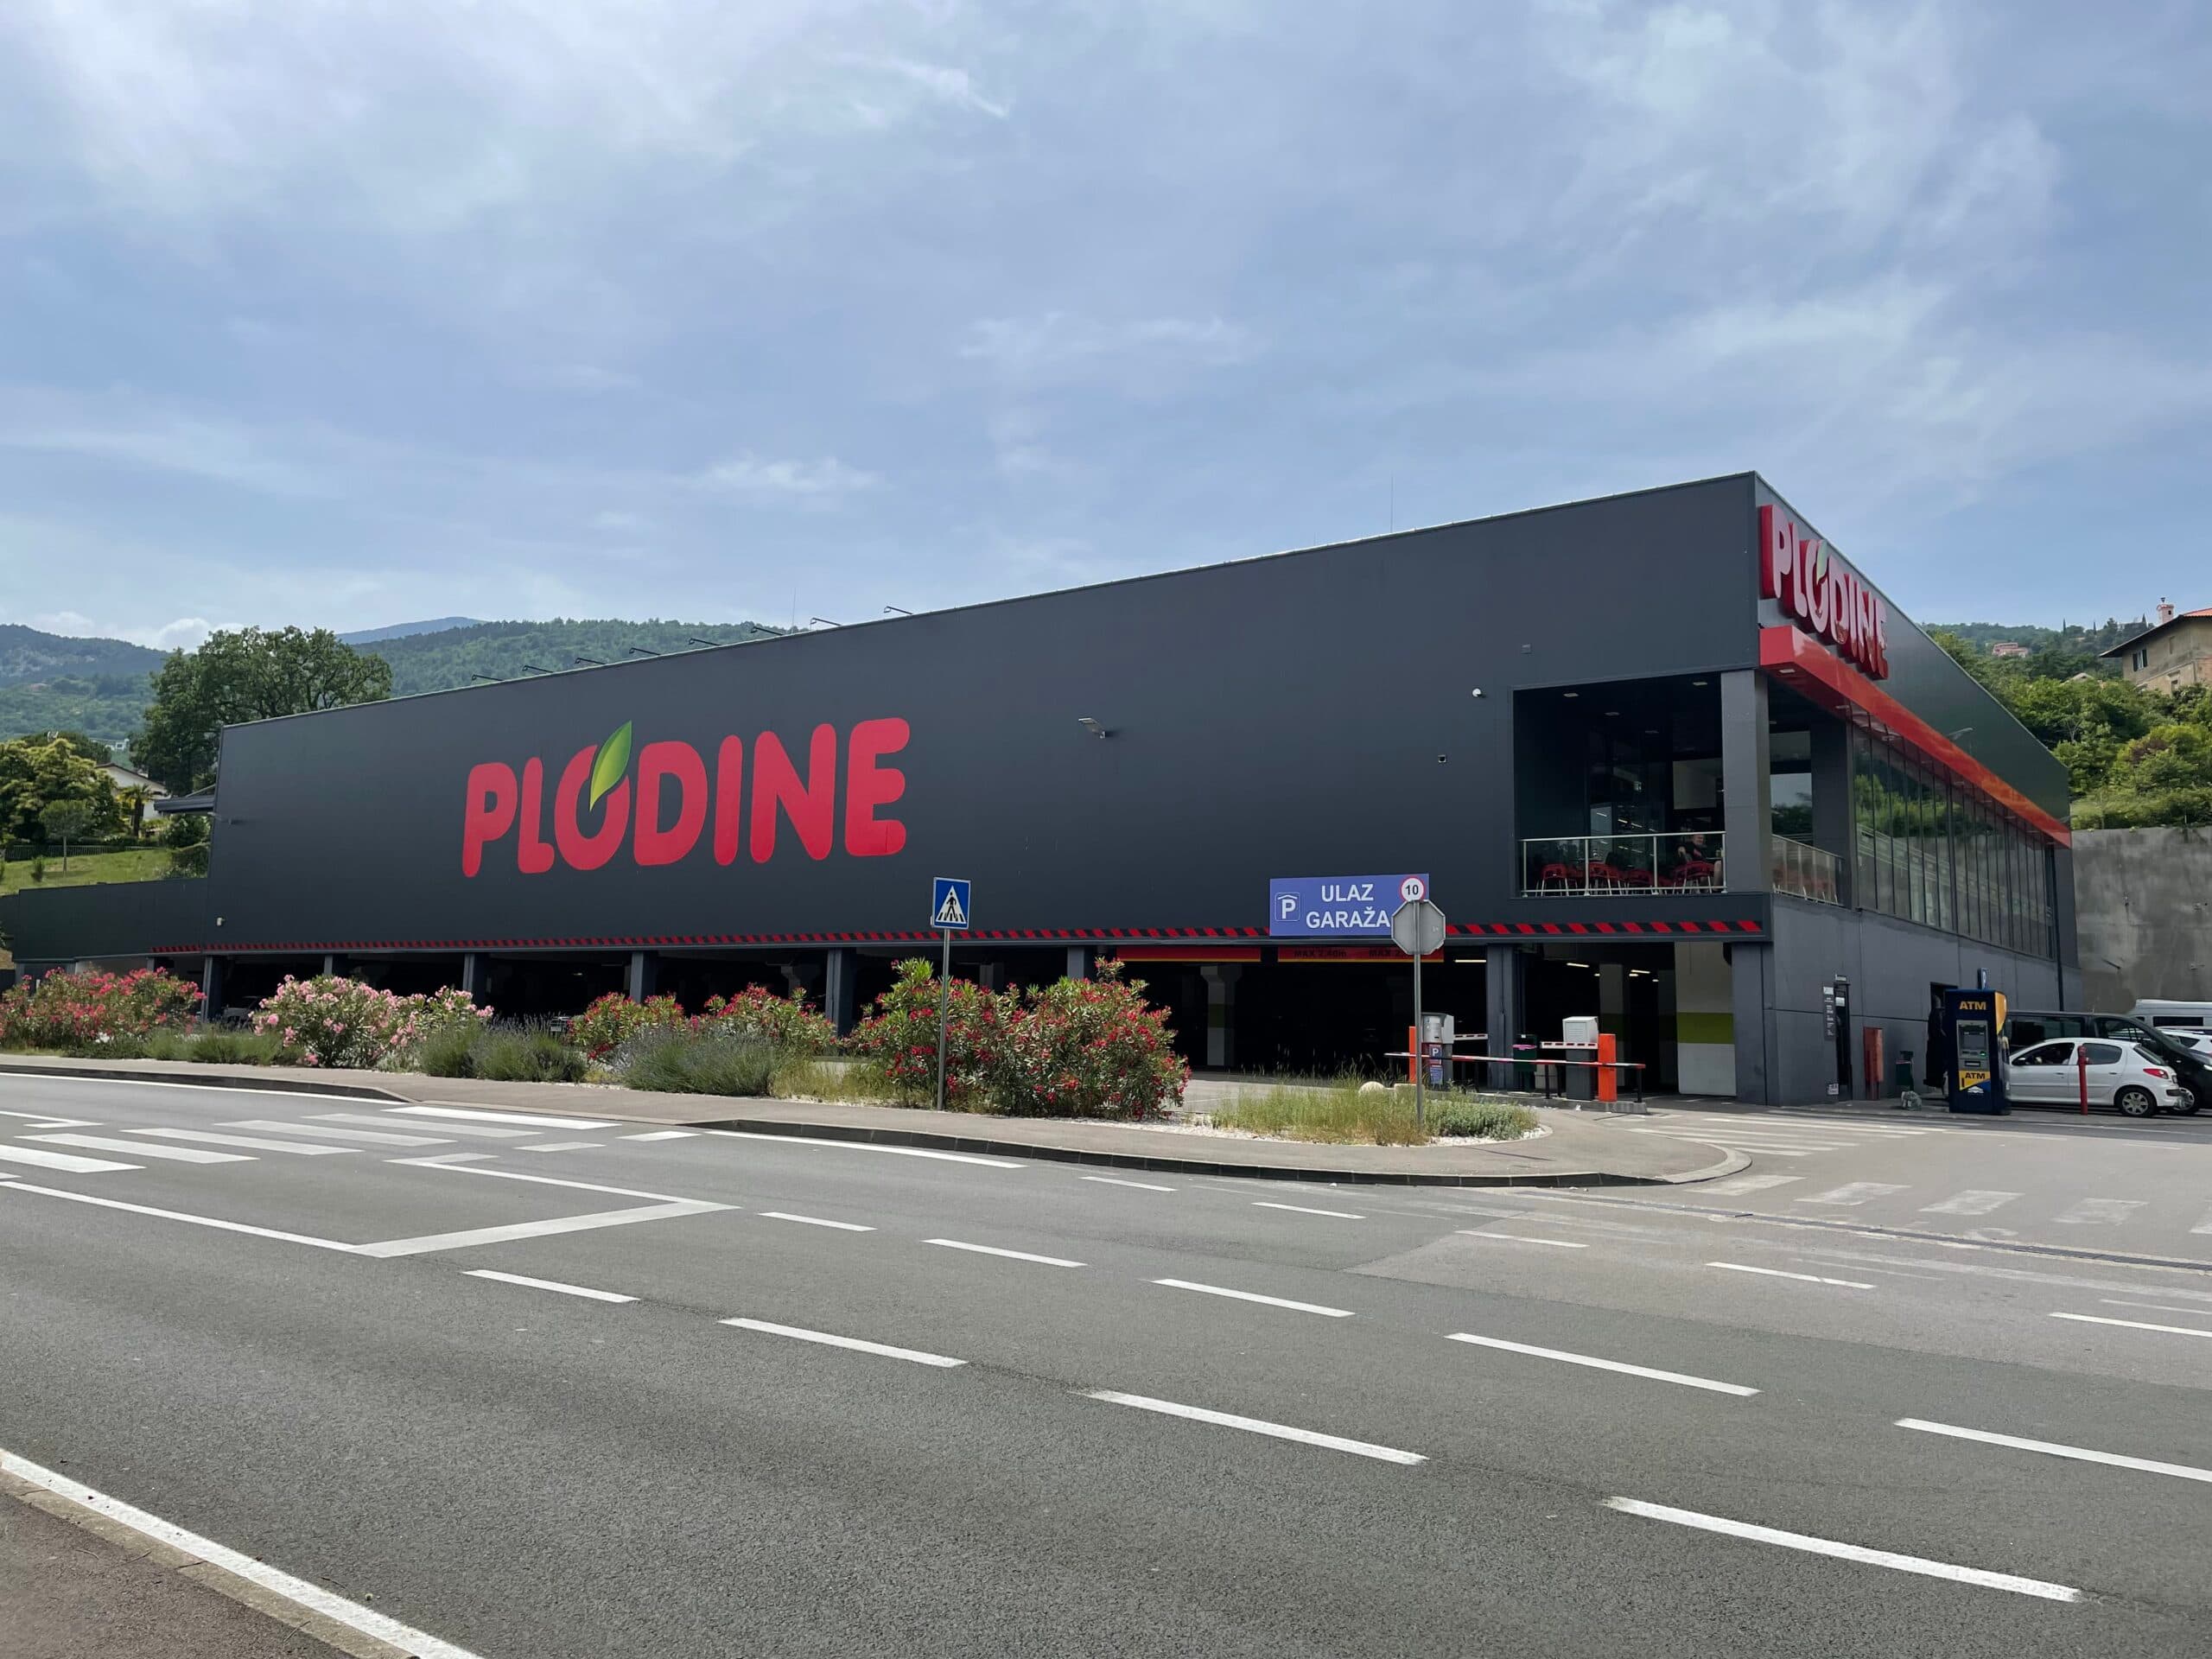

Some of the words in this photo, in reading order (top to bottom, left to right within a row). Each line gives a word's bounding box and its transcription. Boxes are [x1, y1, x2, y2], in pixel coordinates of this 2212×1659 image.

[1759, 504, 1889, 680] PLODINE
[461, 717, 911, 878] PLODINE
[1321, 883, 1374, 902] ULAZ
[1405, 884, 1419, 895] 10
[1281, 899, 1296, 919] P
[1306, 906, 1391, 929] GARAŽA
[1959, 1001, 1987, 1010] ATM
[1432, 1047, 1440, 1057] P
[1964, 1071, 1986, 1080] ATM
